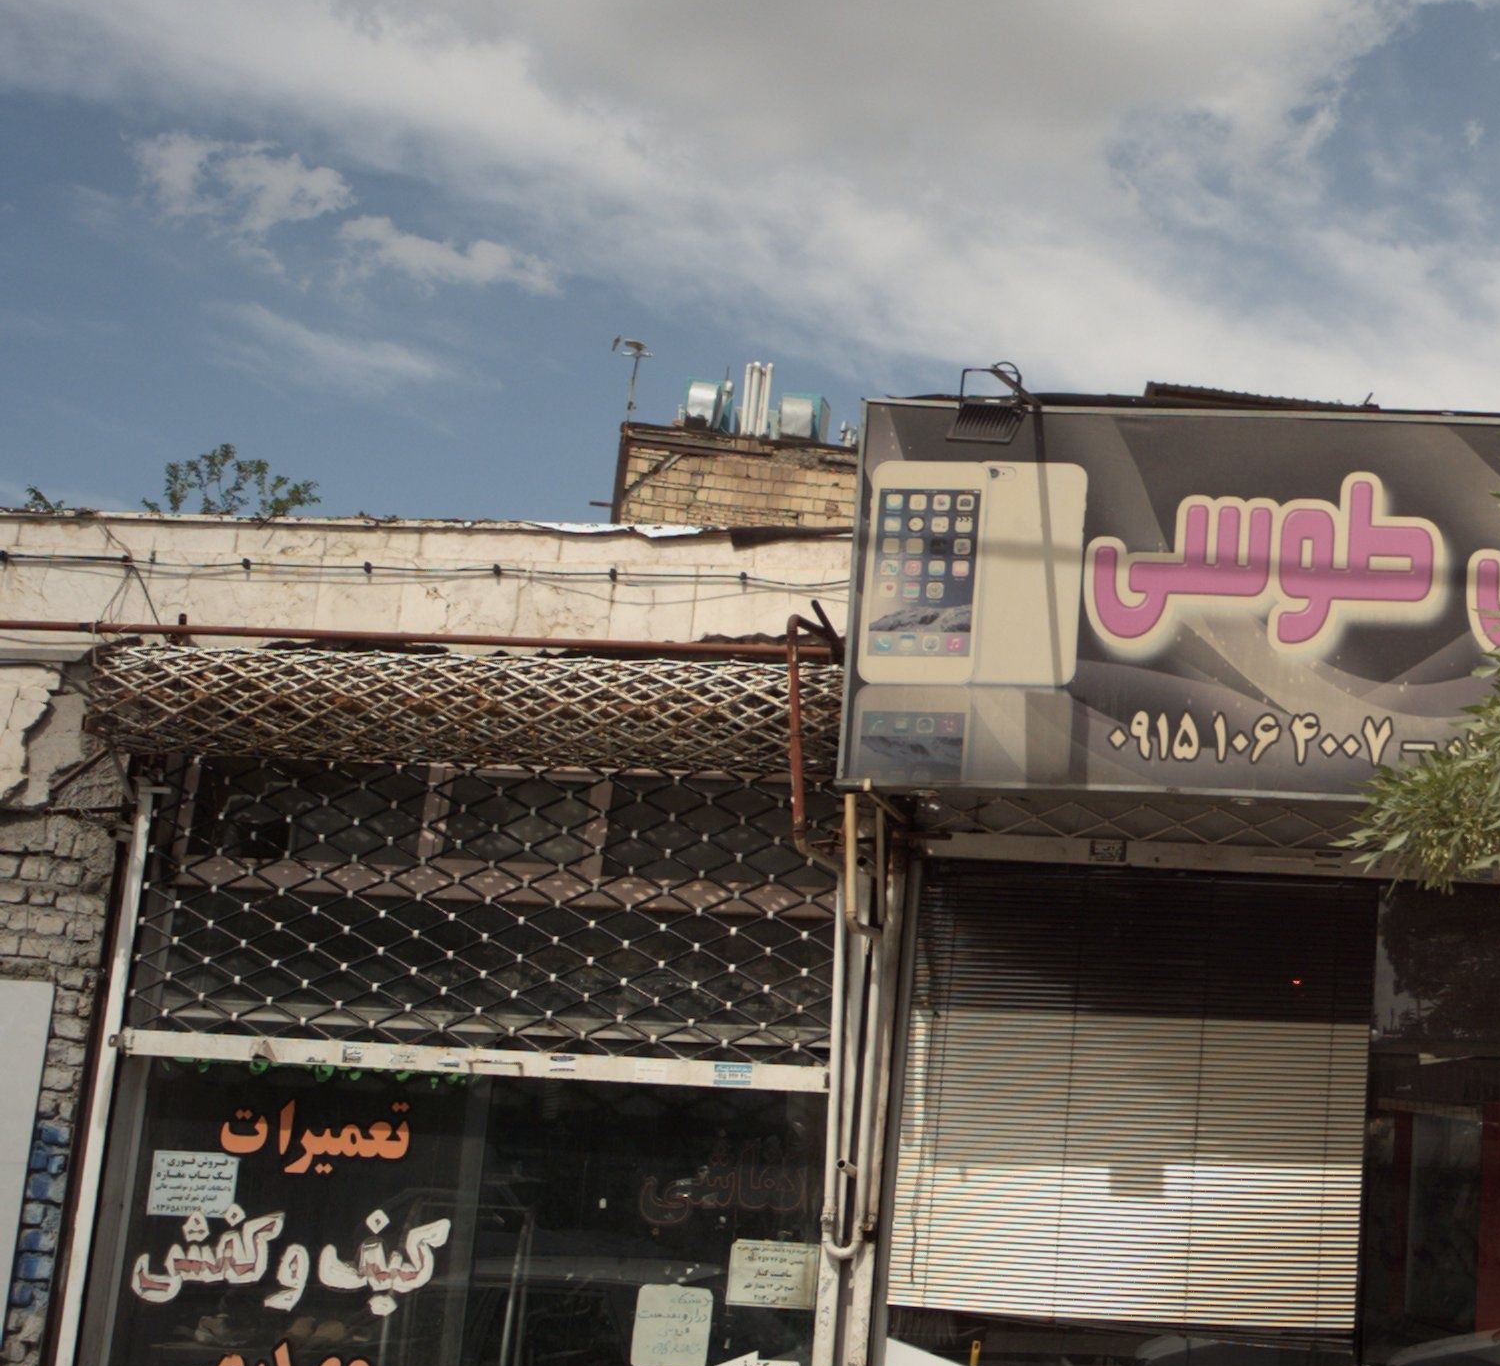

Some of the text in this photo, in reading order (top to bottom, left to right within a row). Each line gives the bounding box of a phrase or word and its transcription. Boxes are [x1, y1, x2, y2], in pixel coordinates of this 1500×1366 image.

[1086, 472, 1446, 654] طوسی
[219, 1098, 412, 1175] تعمیرات
[131, 1202, 453, 1317] کیف و کفش
